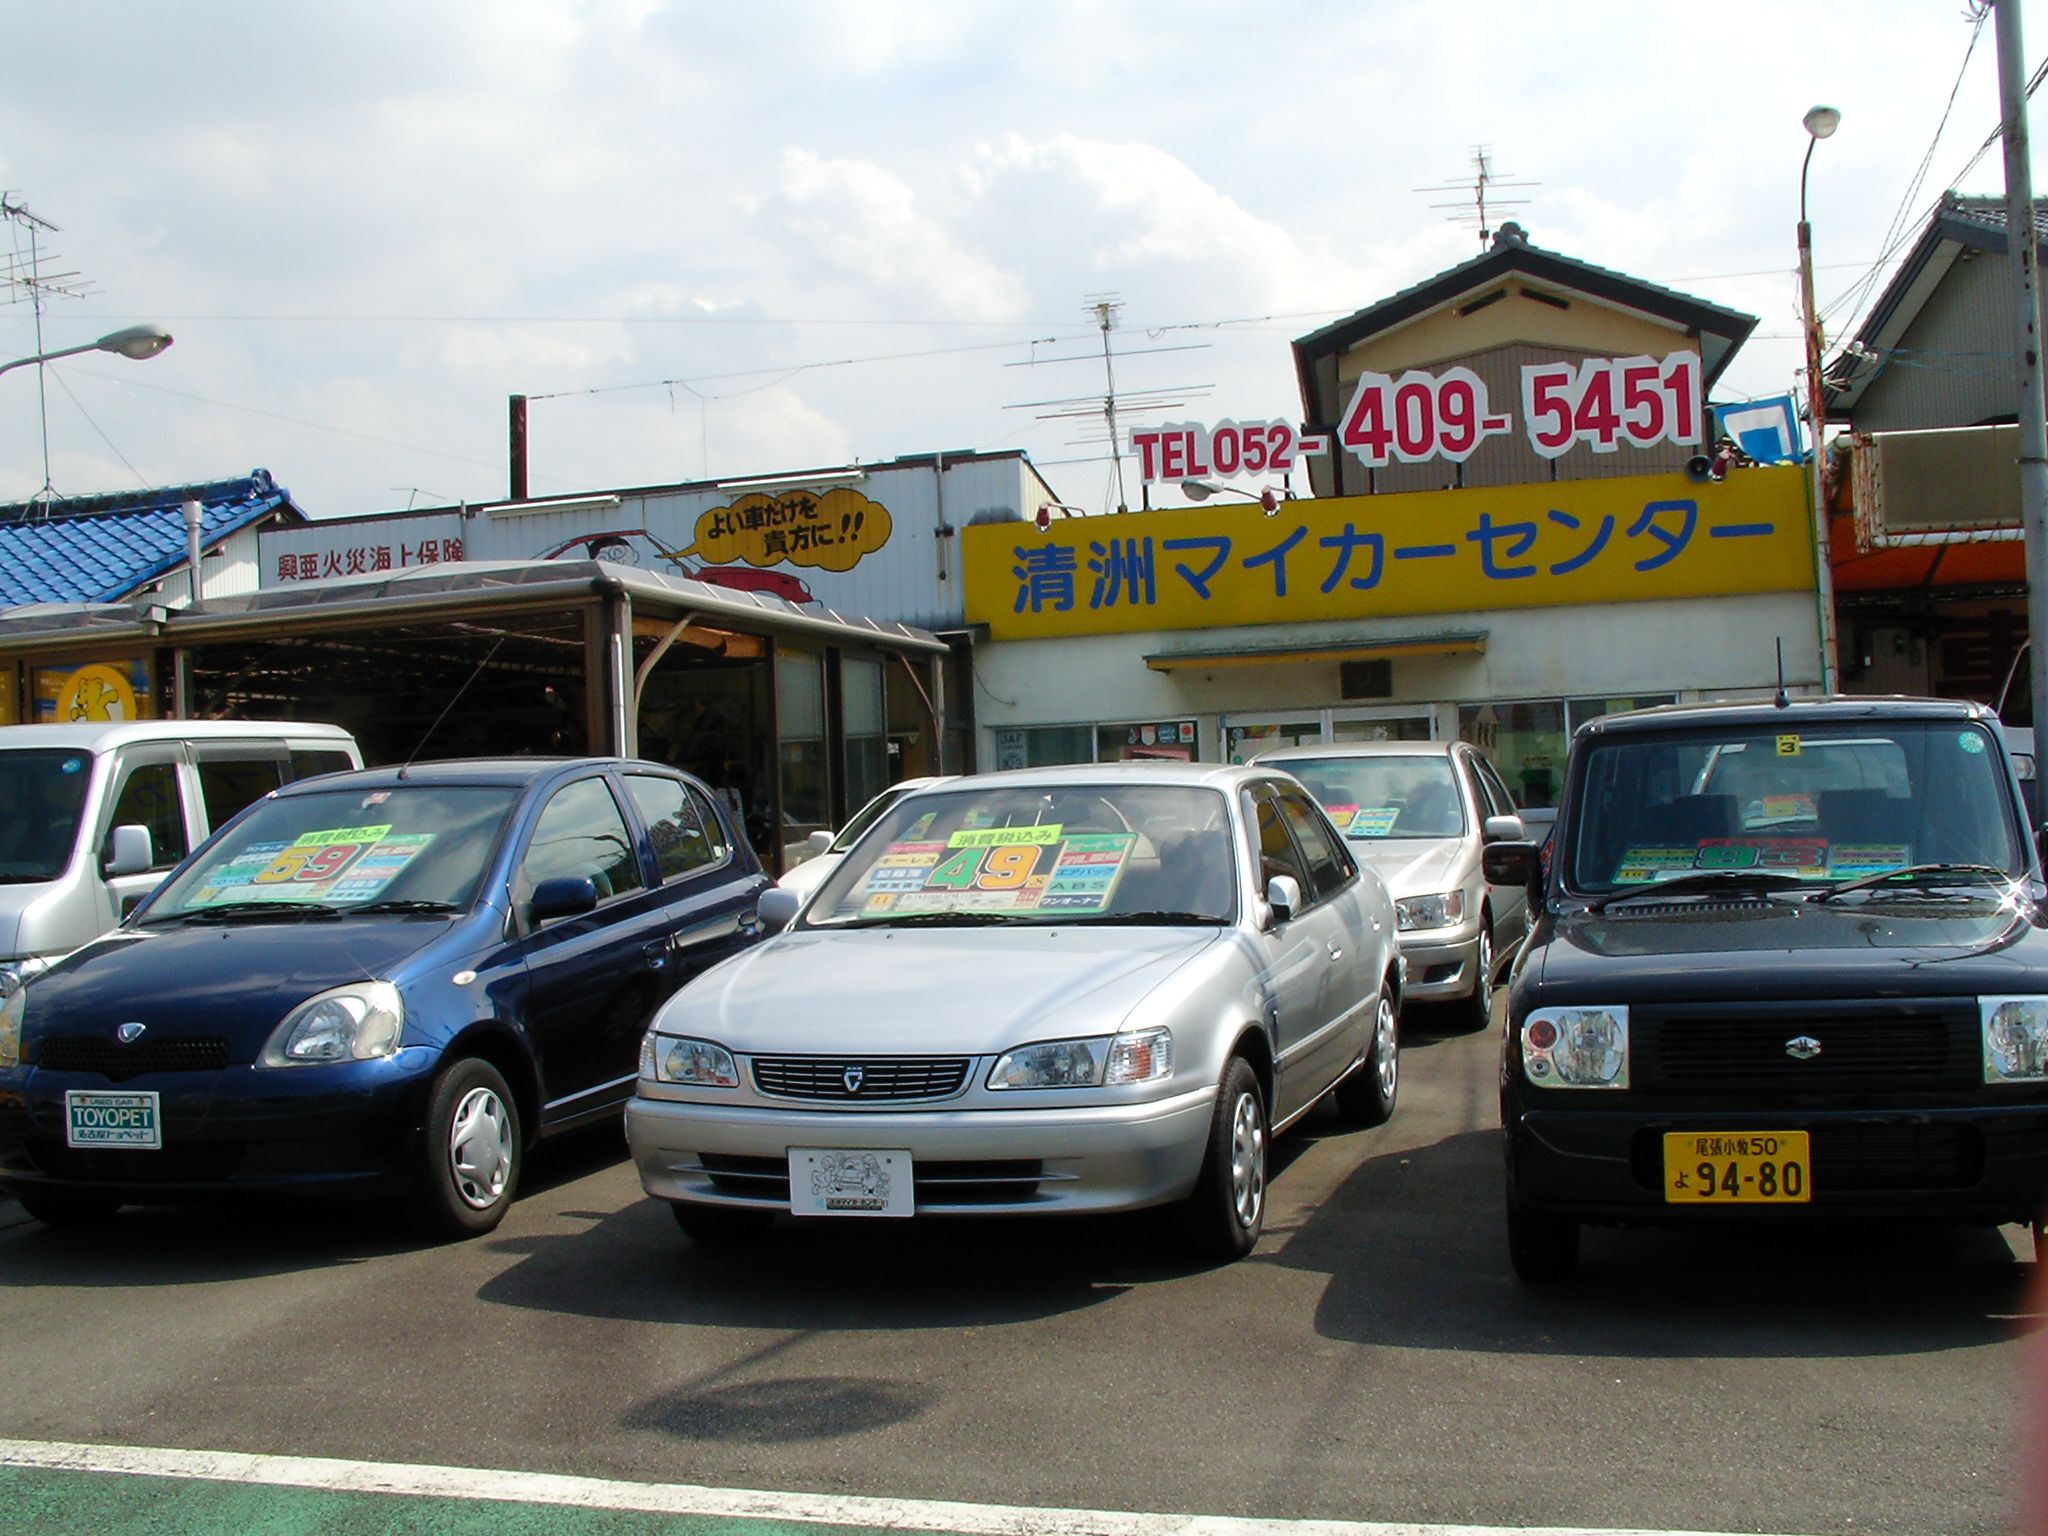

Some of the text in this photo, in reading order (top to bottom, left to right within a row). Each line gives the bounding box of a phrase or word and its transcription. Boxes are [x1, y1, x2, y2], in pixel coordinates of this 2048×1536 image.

[1534, 363, 1692, 448] 5451
[707, 496, 818, 539] よい車だけを
[278, 538, 465, 581] 興亜火災海上保険
[1012, 498, 1776, 613] 清洲マイカーセンター
[956, 829, 1053, 847] 消費税込み
[254, 844, 362, 883] 59
[73, 1108, 151, 1127] TOYOPET
[1674, 1161, 1802, 1197] よ 94-80
